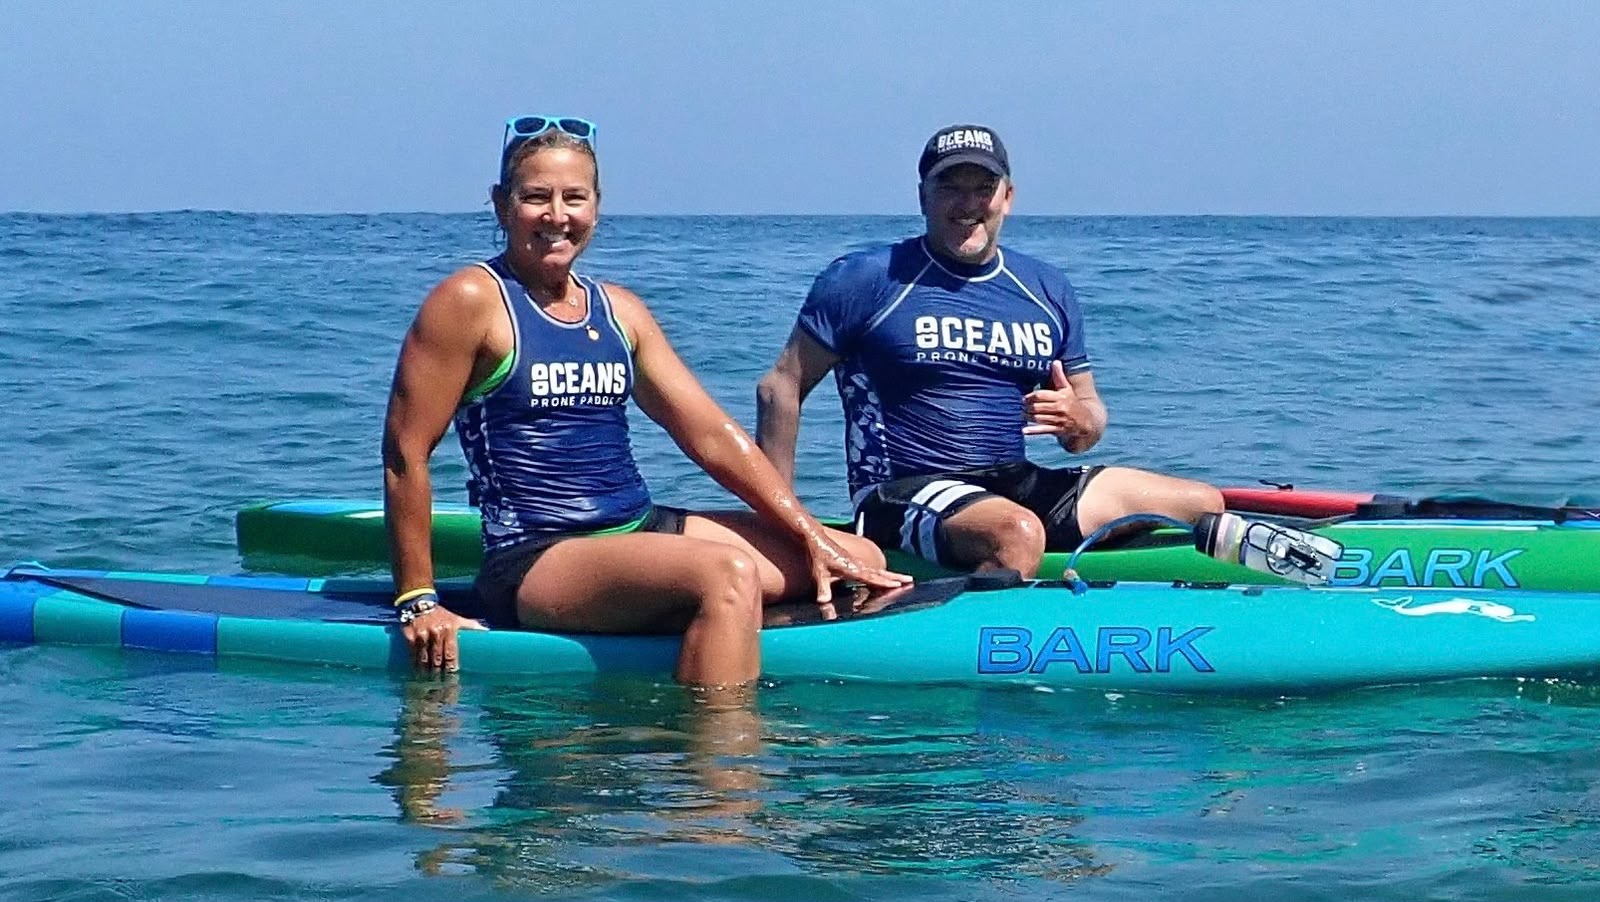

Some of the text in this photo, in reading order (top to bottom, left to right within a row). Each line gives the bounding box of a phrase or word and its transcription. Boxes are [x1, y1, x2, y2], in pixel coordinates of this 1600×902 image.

[915, 315, 1053, 357] OCEANS
[530, 362, 627, 396] OCEANS
[530, 395, 576, 408] PRONE
[1331, 547, 1529, 588] BARK
[977, 626, 1217, 675] BARK
